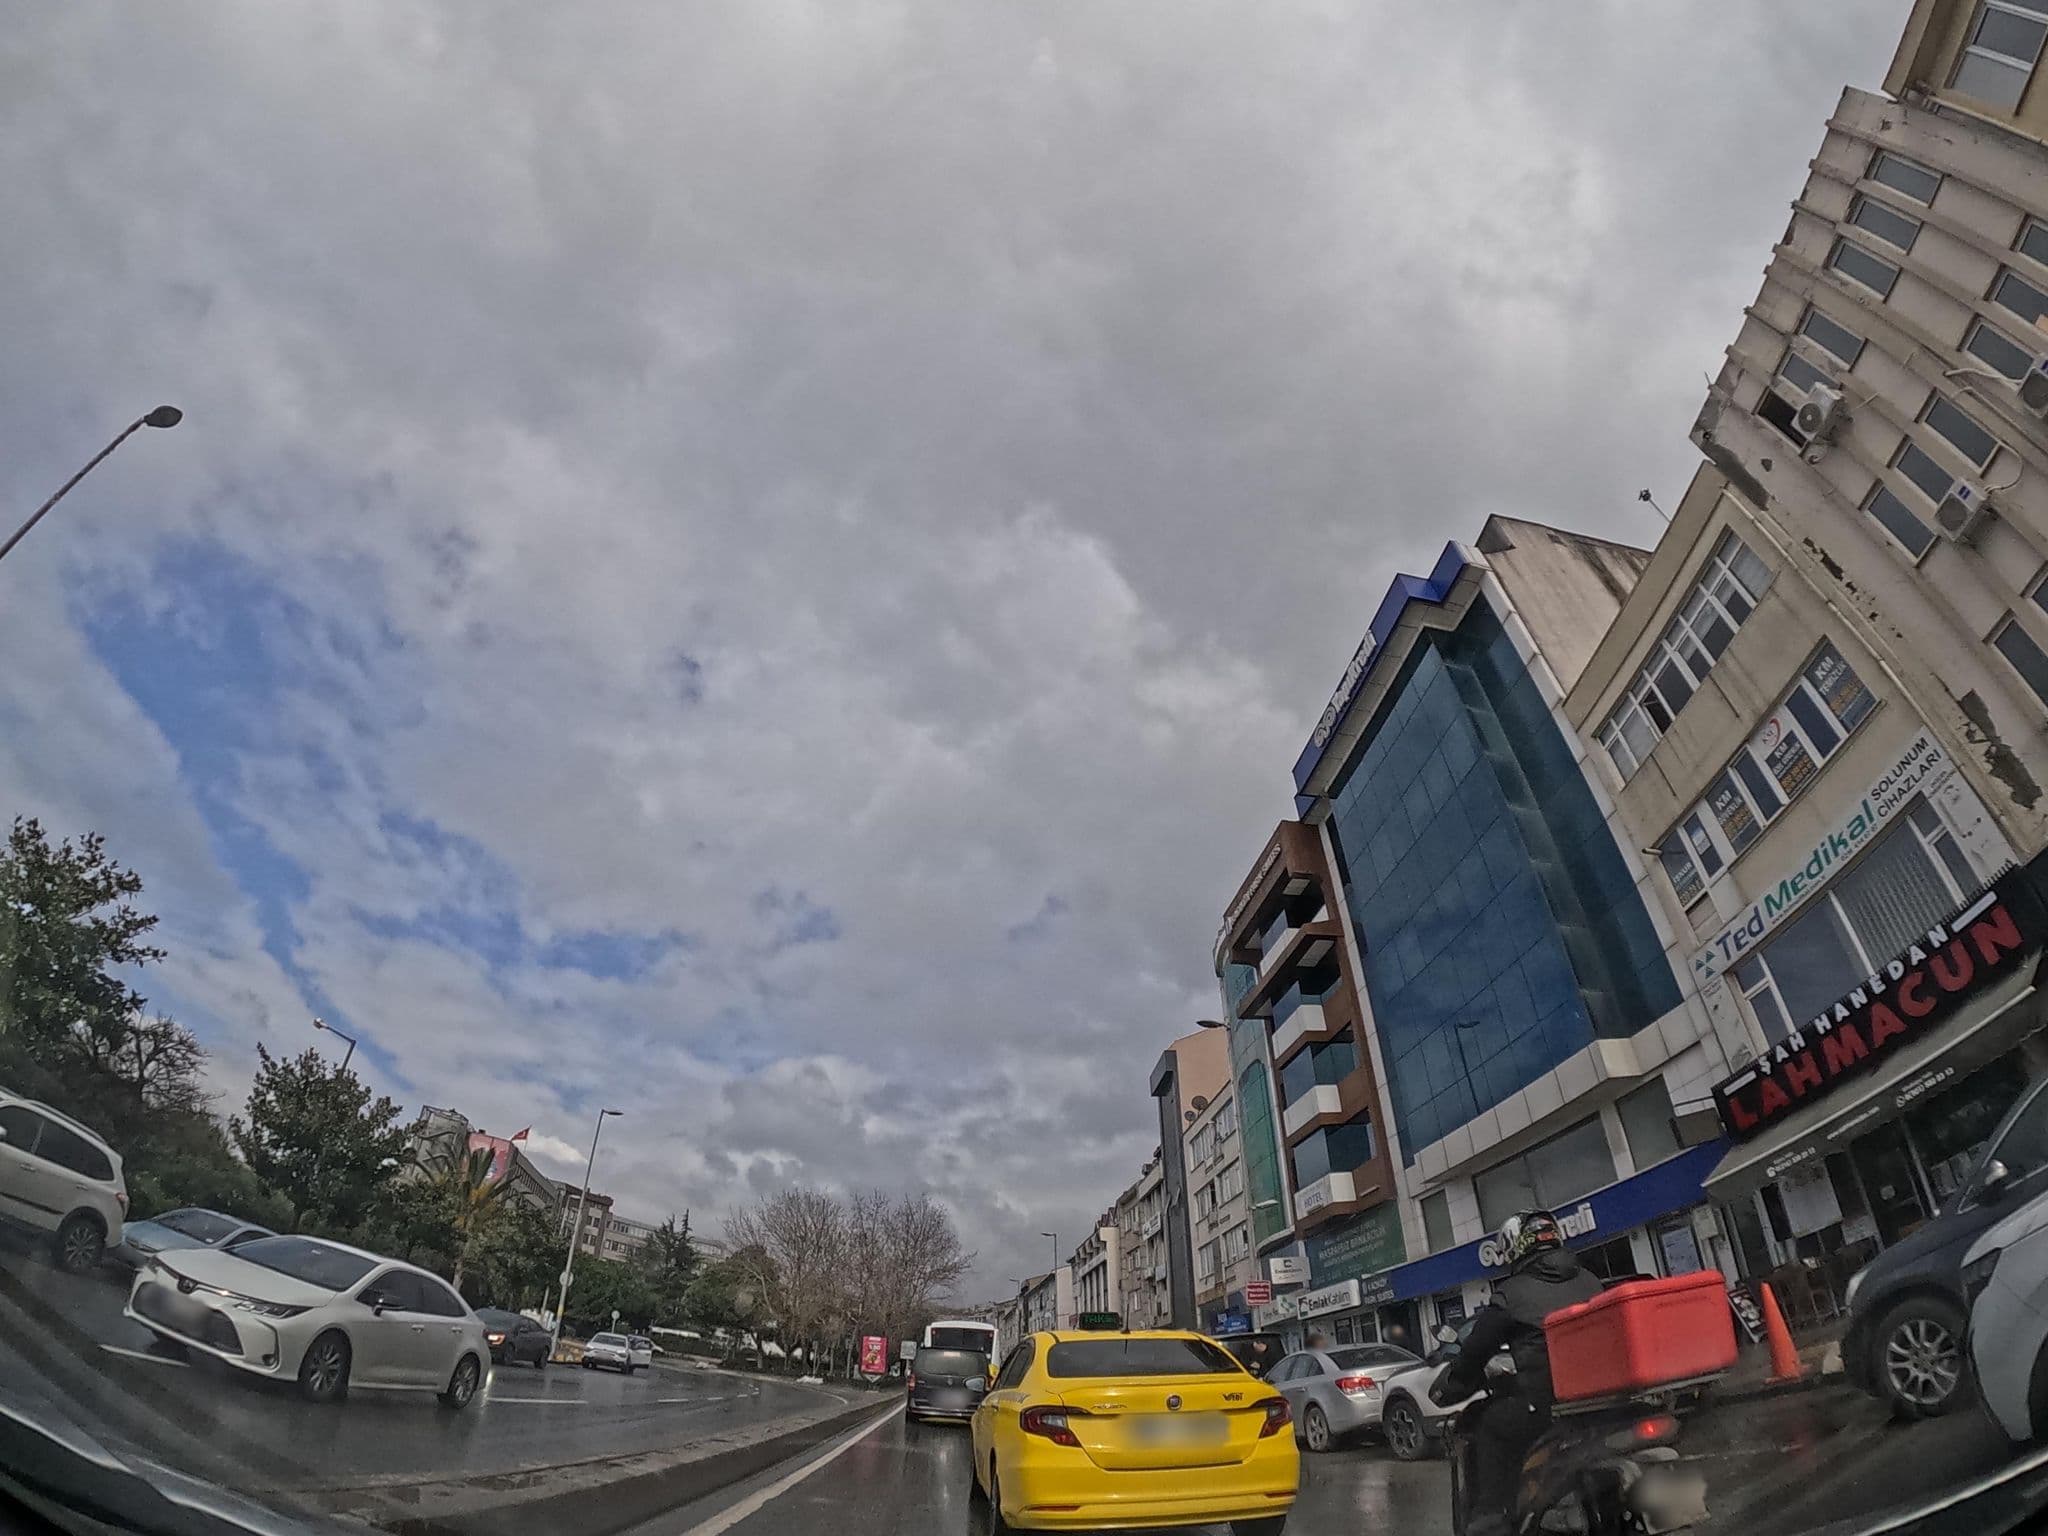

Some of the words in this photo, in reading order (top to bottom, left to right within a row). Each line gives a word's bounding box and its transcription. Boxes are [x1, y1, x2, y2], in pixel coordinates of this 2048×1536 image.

[1815, 655, 1834, 679] KM
[1871, 737, 1930, 800] SOLUNUM
[1878, 749, 1942, 818] CİHAZLARI
[1716, 907, 1765, 961] Ted
[1762, 799, 1876, 918] Medikal
[1728, 904, 2025, 1132] LAHMACUN
[1758, 1031, 1806, 1075] ŞAH
[1814, 923, 1950, 1036] HANEDAN
[1304, 1192, 1324, 1208] HOTEL
